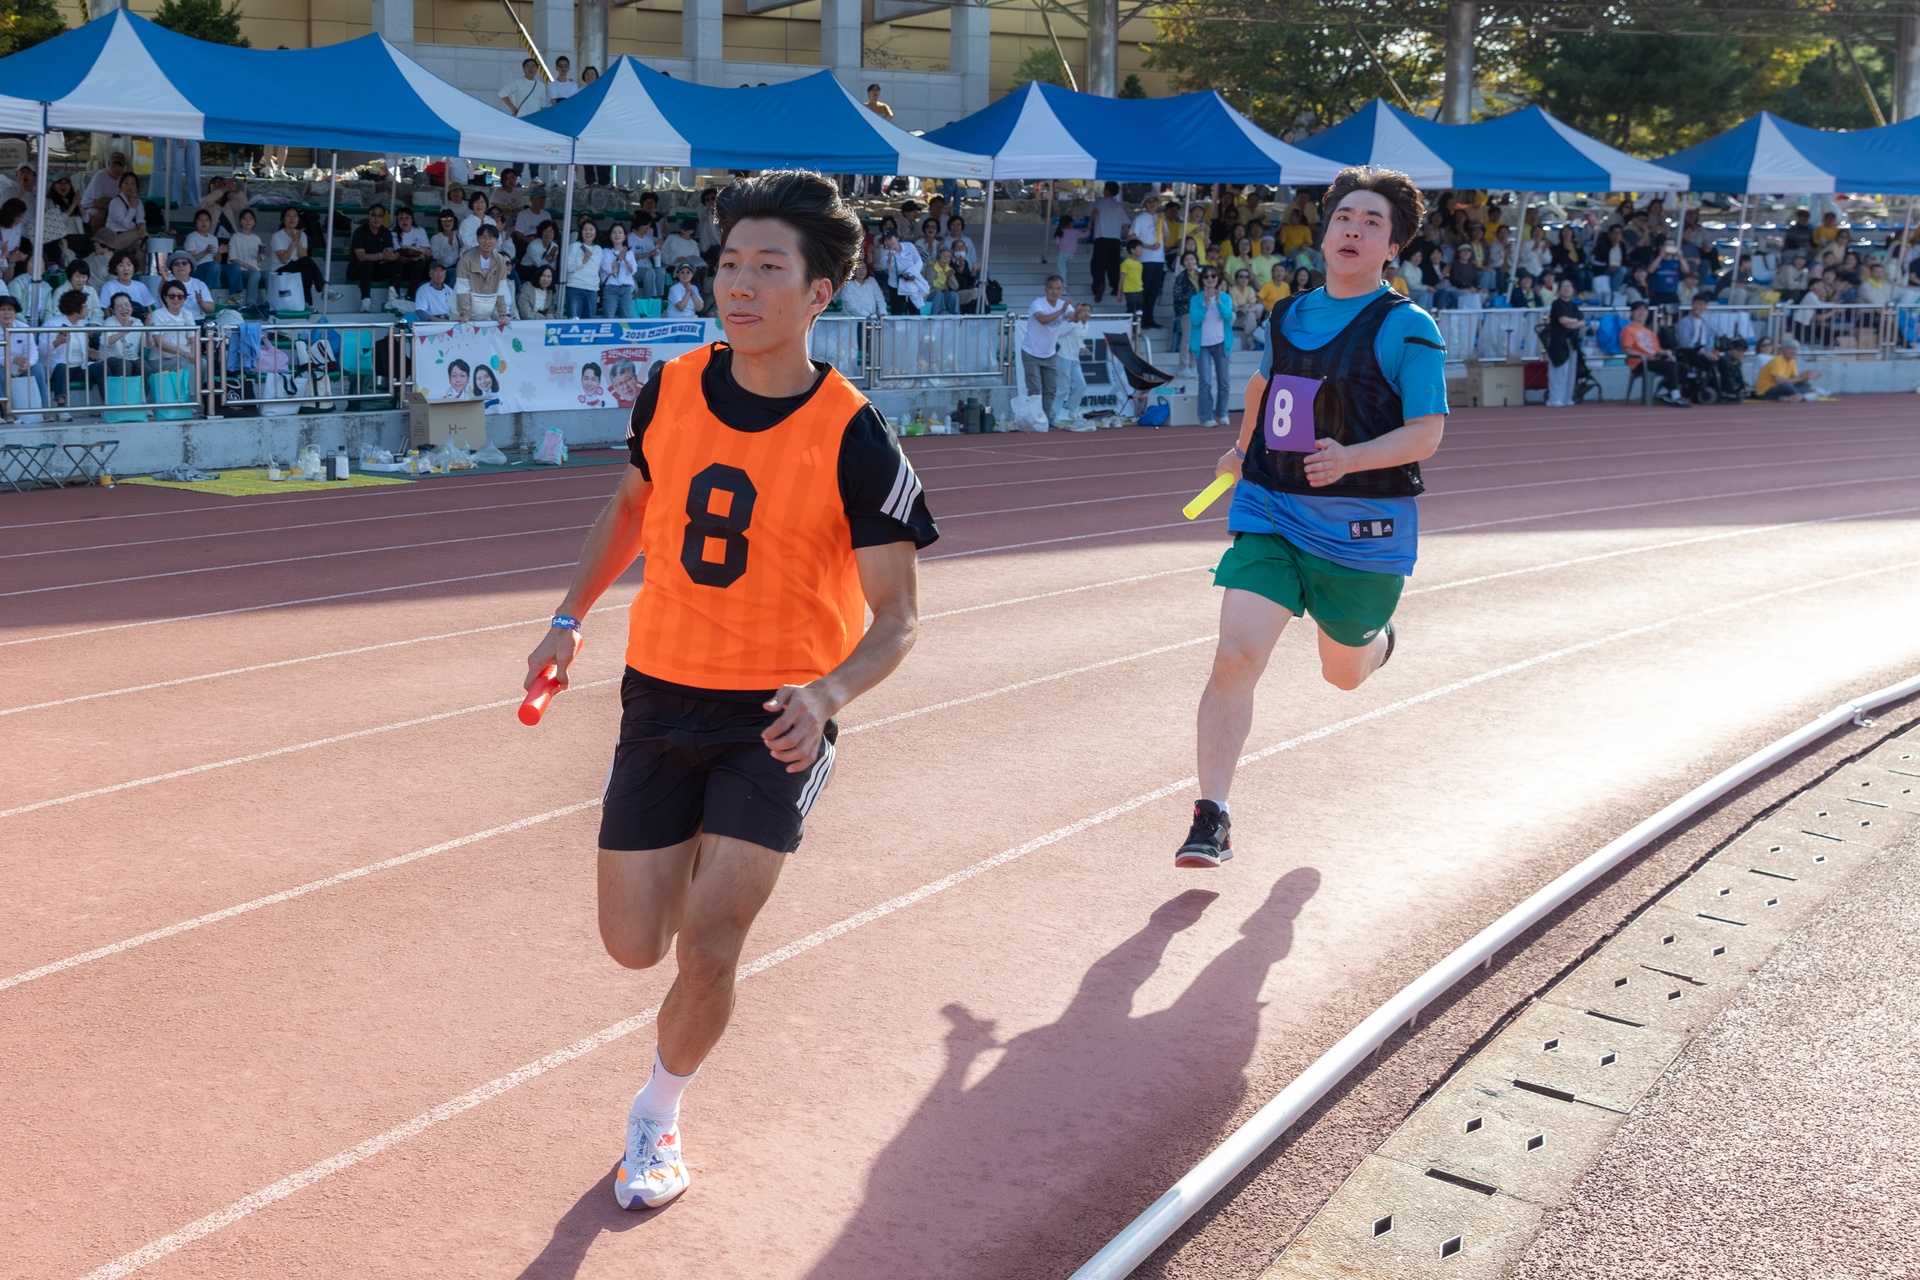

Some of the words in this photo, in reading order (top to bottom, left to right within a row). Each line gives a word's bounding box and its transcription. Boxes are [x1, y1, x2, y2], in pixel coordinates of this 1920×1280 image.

[625, 331, 646, 339] 2026
[648, 327, 669, 338] 전교인
[670, 325, 698, 333] 체육대회
[1272, 388, 1294, 437] 8
[680, 462, 758, 588] 8
